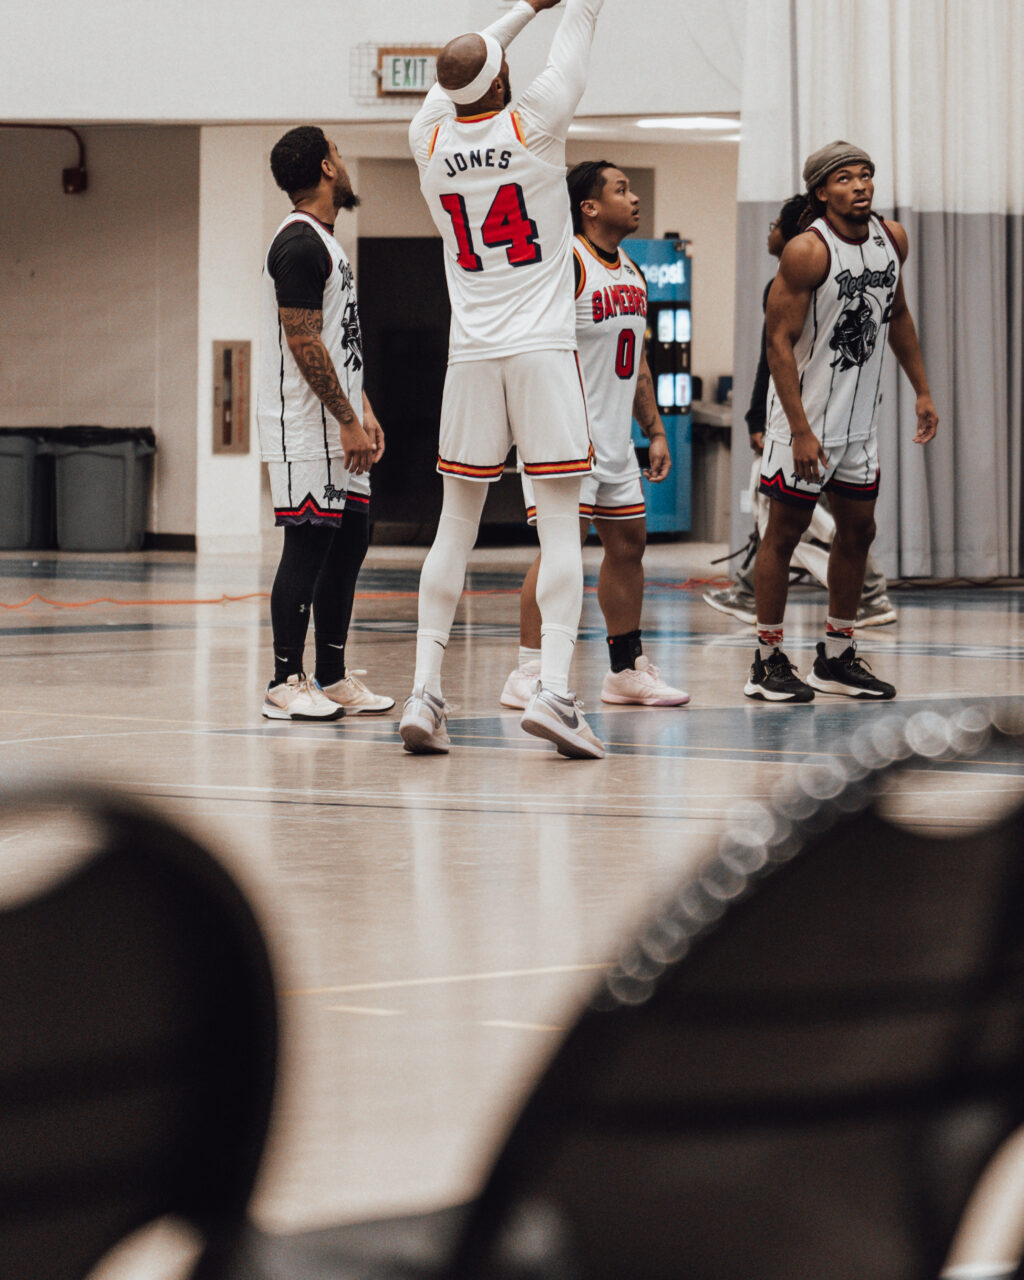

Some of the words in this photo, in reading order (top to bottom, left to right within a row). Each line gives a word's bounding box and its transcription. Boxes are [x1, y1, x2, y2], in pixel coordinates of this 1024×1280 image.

[392, 58, 427, 86] EXIT
[444, 148, 512, 178] JONES
[440, 182, 542, 272] 14
[616, 328, 636, 380] 0
